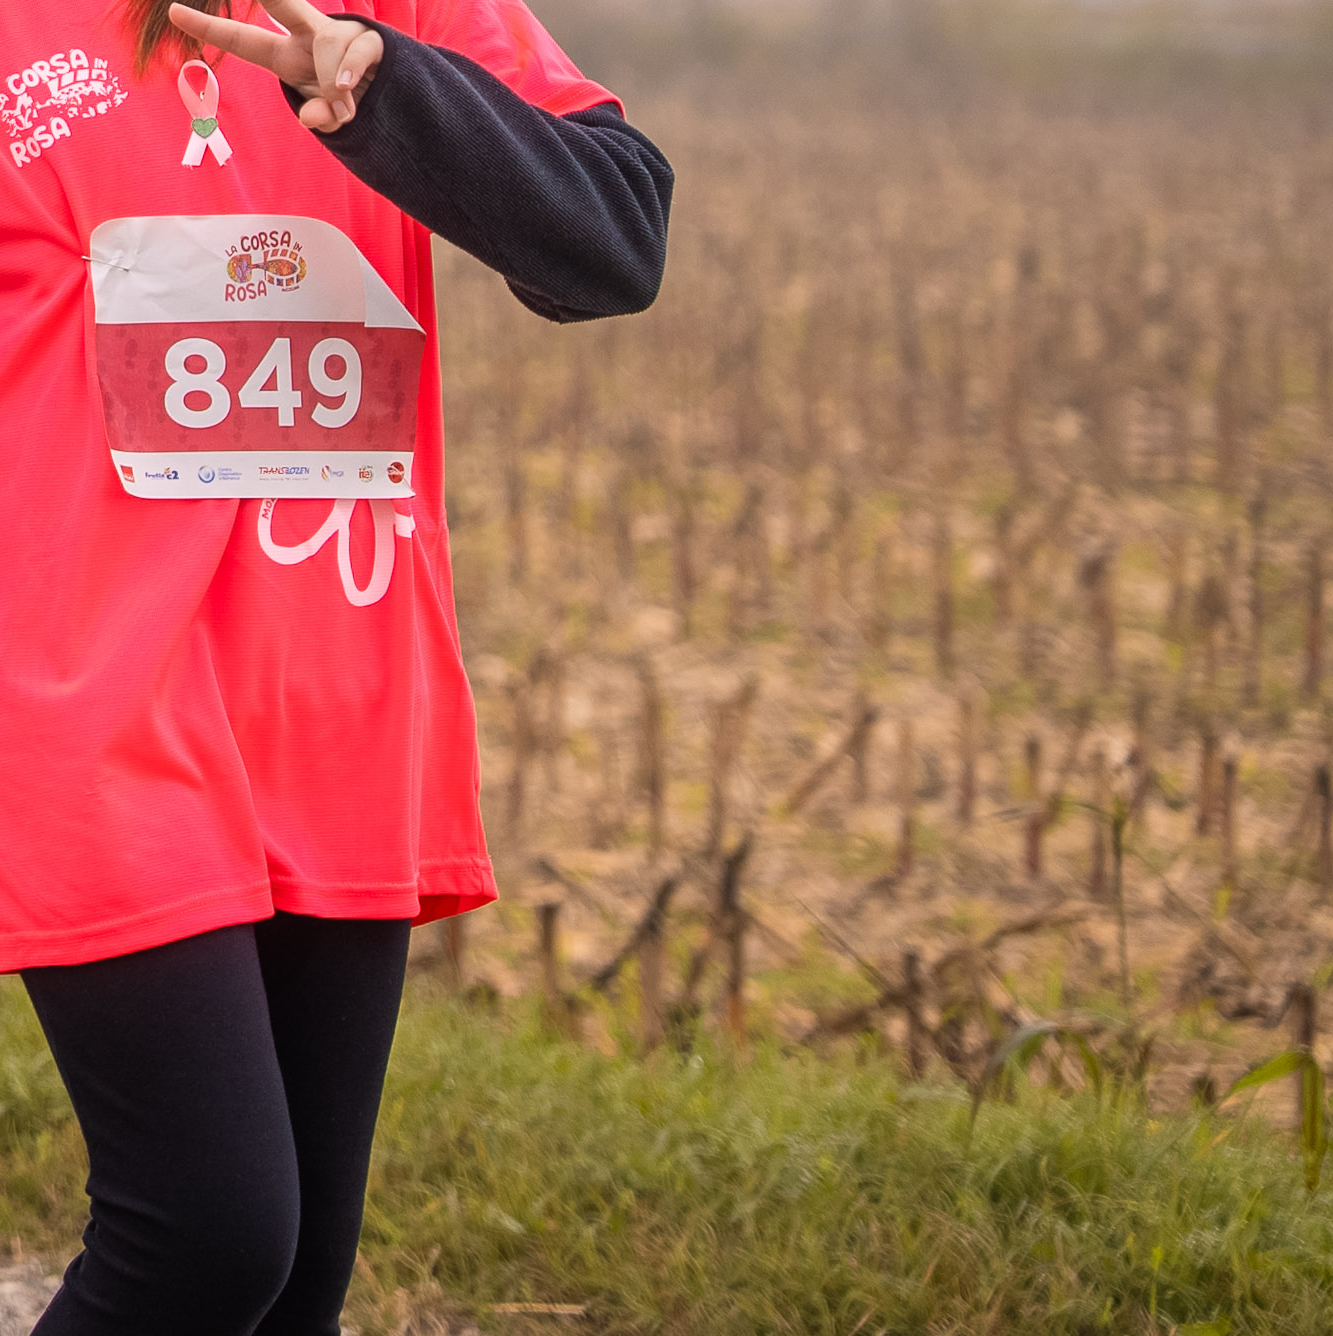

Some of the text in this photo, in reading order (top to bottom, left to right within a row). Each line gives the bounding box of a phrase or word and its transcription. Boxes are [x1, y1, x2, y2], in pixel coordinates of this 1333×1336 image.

[6, 49, 90, 95] CORSA
[93, 57, 108, 69] IN
[9, 116, 72, 167] ROSA
[225, 230, 303, 257] LA CORSA IN
[225, 280, 267, 302] ROSA
[163, 337, 363, 428] 849
